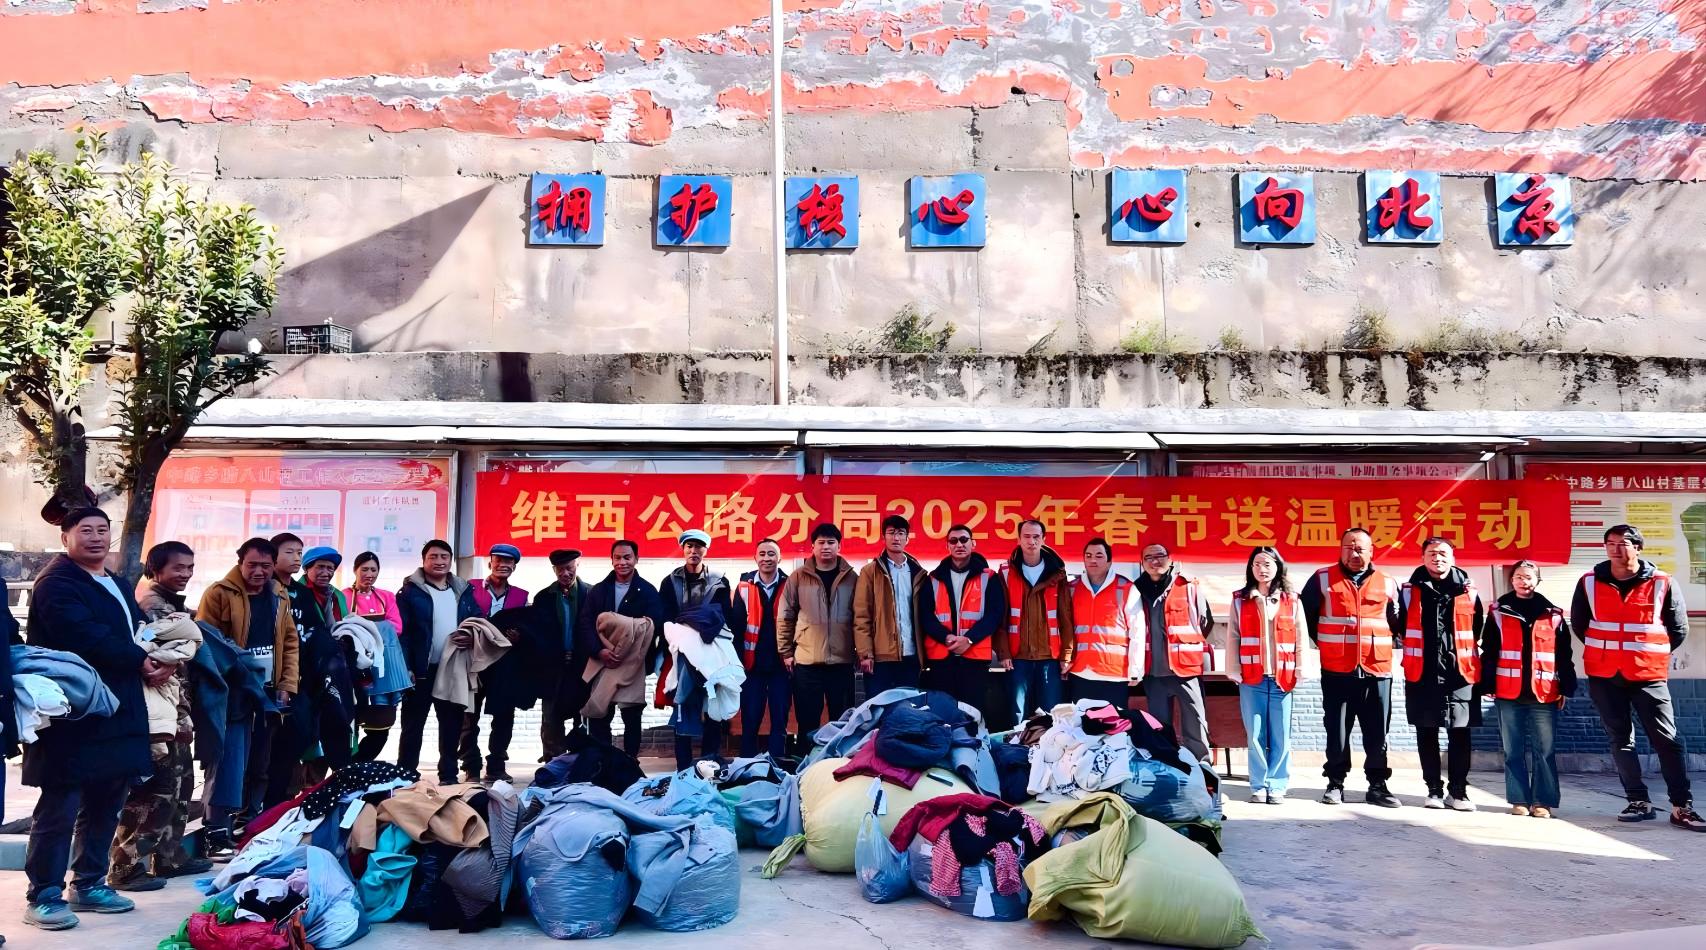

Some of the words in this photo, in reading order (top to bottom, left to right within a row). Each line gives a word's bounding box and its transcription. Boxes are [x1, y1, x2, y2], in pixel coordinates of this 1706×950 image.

[537, 179, 975, 241] 拥护核心
[1120, 175, 1561, 240] 心向北京
[510, 489, 1531, 550] 维西公路分局2025年春节送温暖活动
